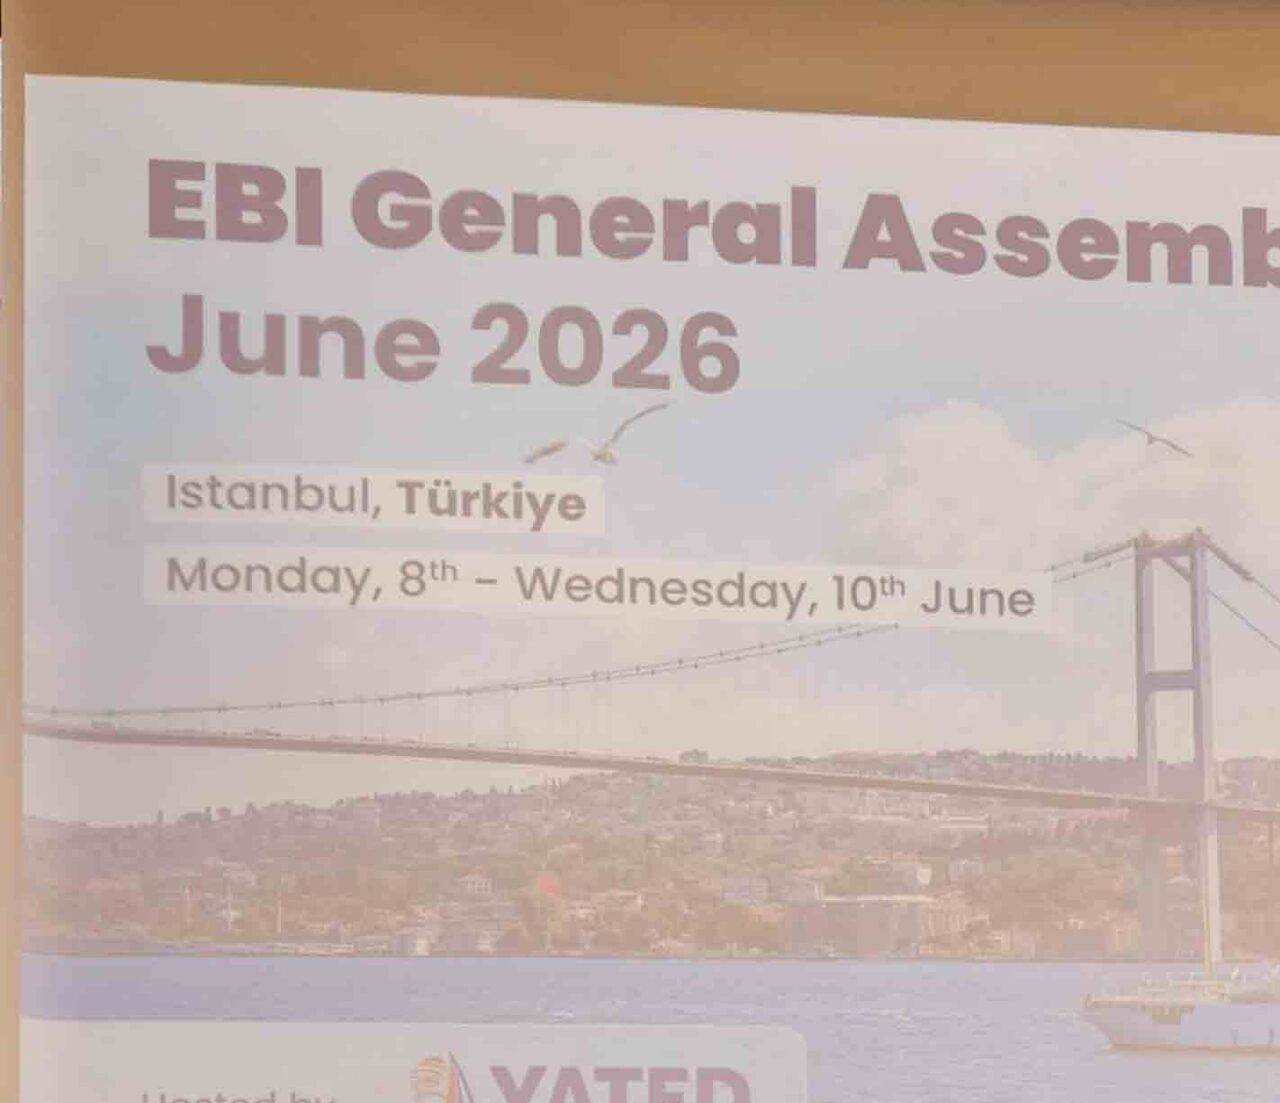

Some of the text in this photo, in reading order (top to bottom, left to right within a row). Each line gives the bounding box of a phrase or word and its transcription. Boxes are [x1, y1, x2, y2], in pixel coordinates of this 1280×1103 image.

[148, 159, 323, 247] EBI
[350, 169, 817, 268] General
[146, 294, 740, 394] June 2026
[166, 474, 587, 532] Istanbul, Türkiye
[166, 556, 382, 605] Monday,
[515, 565, 818, 620] Wednesday,
[920, 580, 1036, 616] June
